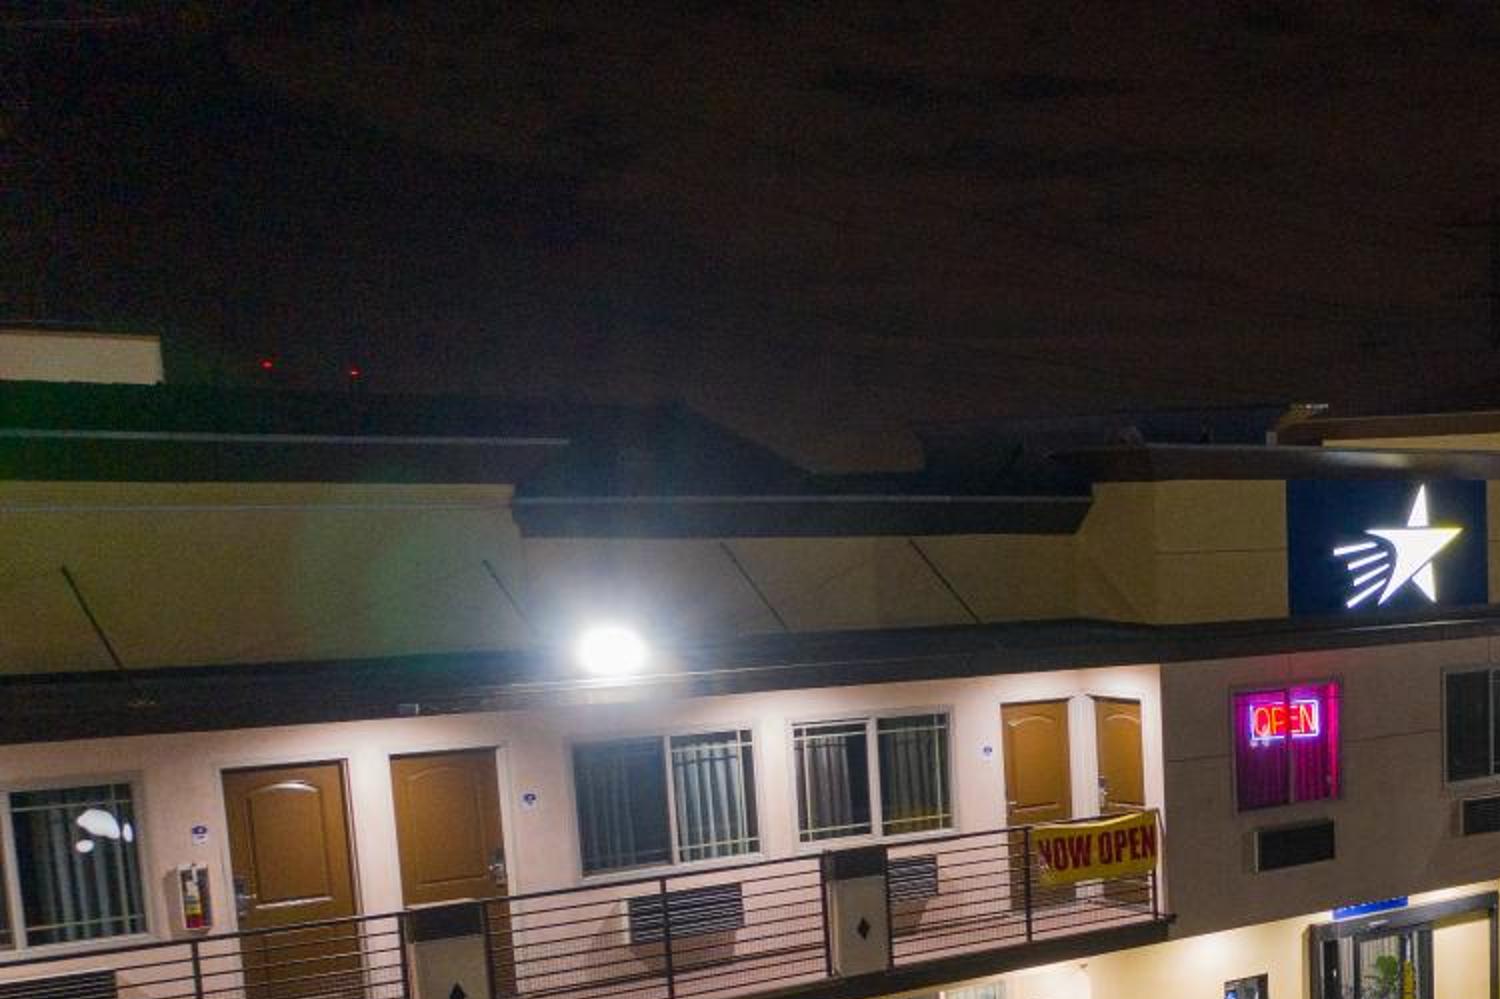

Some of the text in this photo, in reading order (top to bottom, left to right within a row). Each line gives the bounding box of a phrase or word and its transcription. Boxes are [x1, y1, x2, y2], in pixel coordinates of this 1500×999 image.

[1254, 703, 1316, 737] OPEN
[1038, 824, 1156, 871] NOW OPEN
